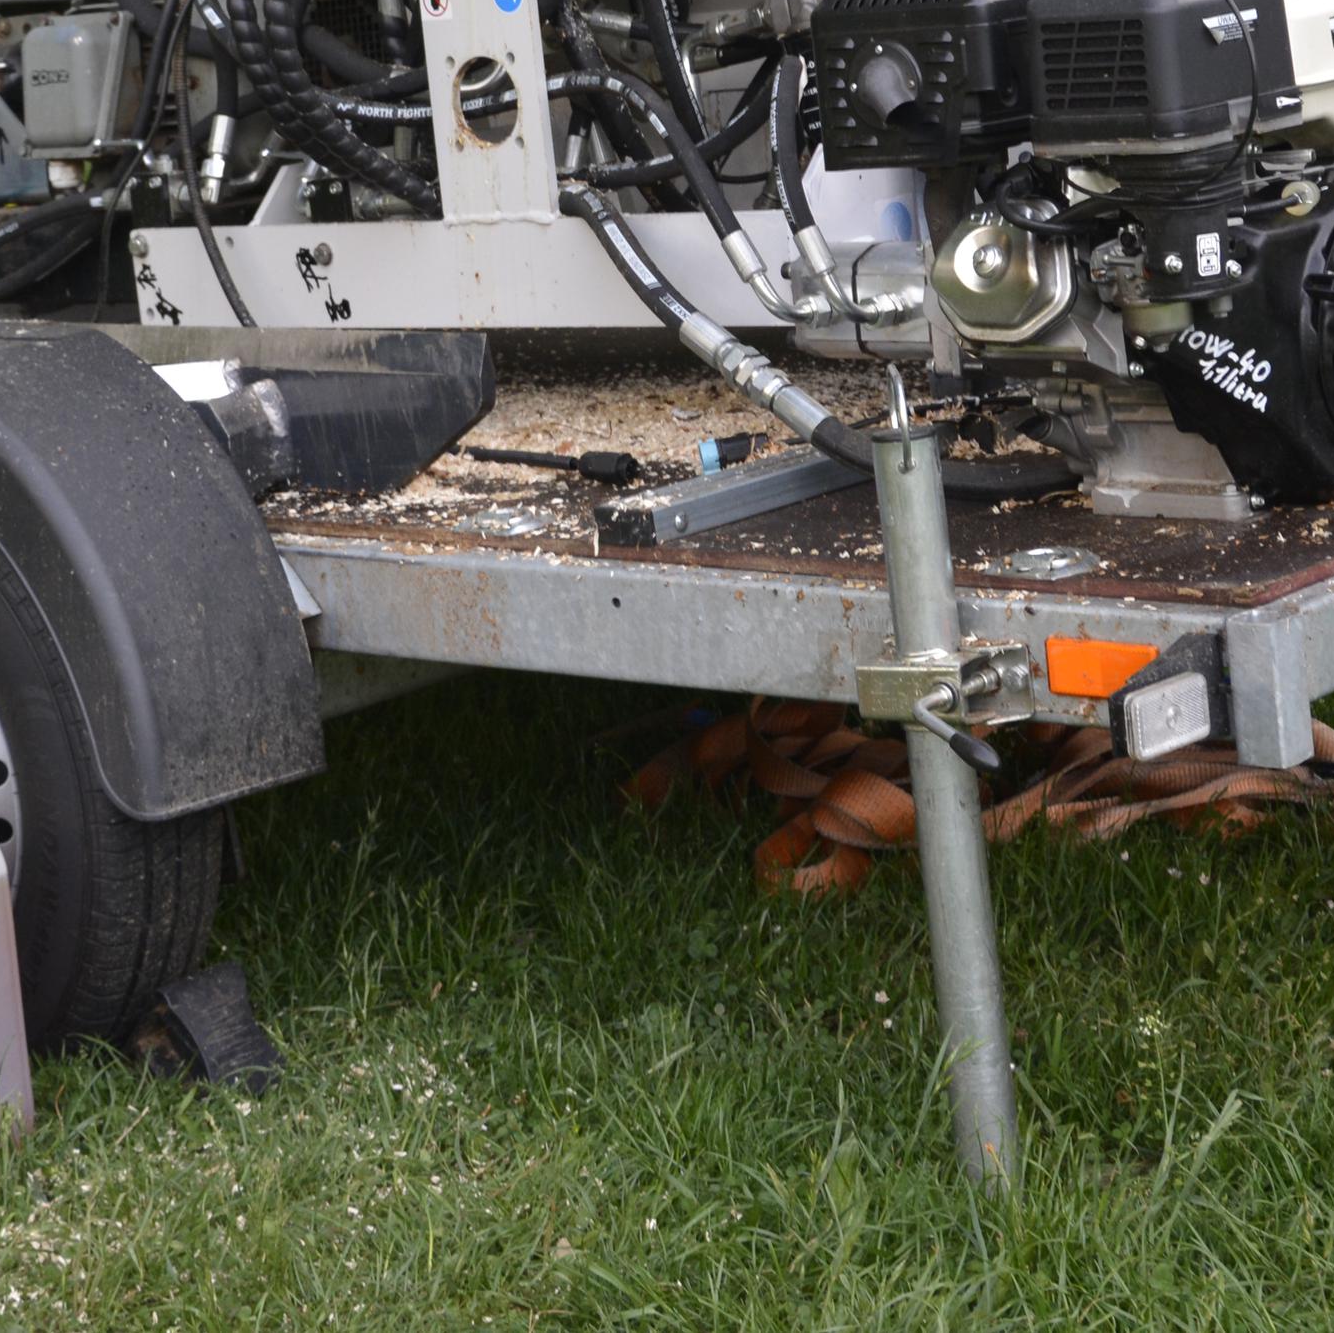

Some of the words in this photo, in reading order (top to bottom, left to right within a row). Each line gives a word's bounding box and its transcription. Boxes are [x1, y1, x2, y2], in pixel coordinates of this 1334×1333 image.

[357, 106, 393, 117] NORTH
[397, 106, 433, 118] FIGHTE
[1178, 323, 1272, 383] 10W-40
